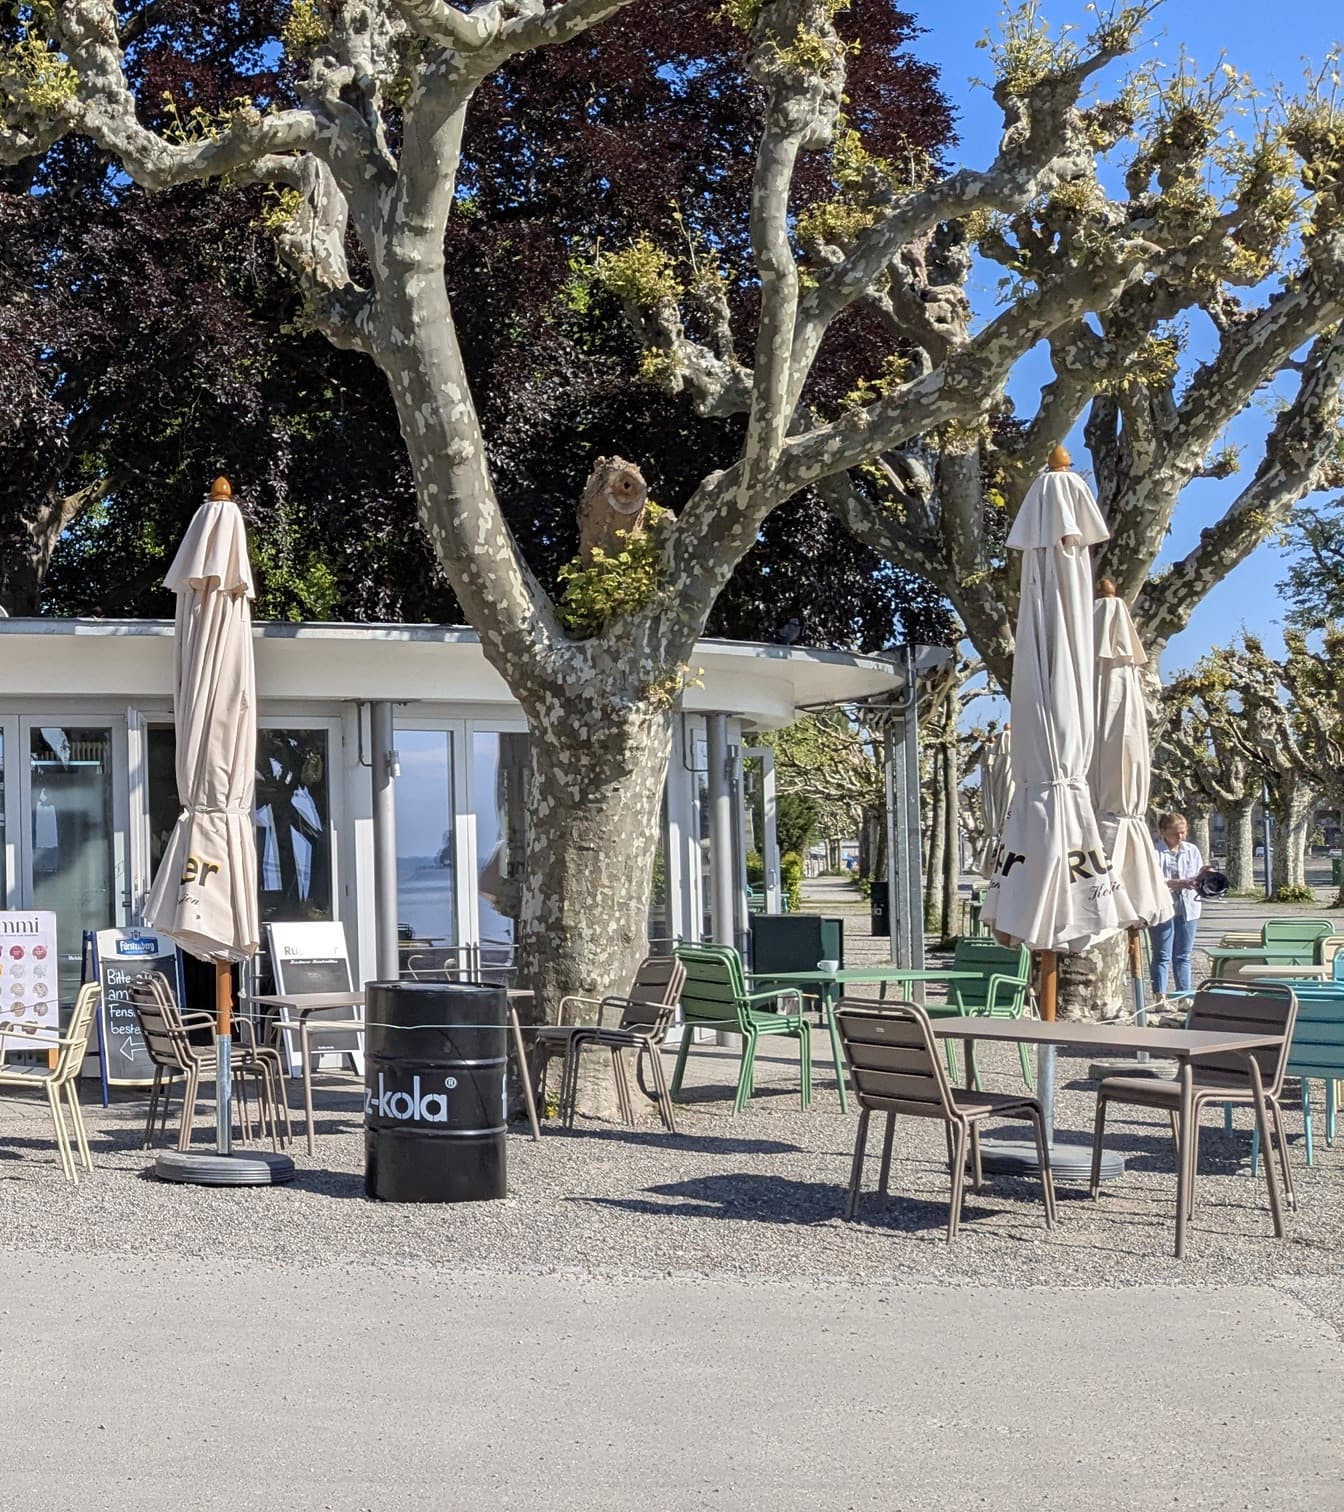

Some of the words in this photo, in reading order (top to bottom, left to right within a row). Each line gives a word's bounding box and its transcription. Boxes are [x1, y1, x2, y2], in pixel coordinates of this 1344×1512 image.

[107, 968, 131, 985] Bitte
[108, 989, 129, 1001] am
[108, 1003, 136, 1018] Fens
[110, 1021, 141, 1035] beste
